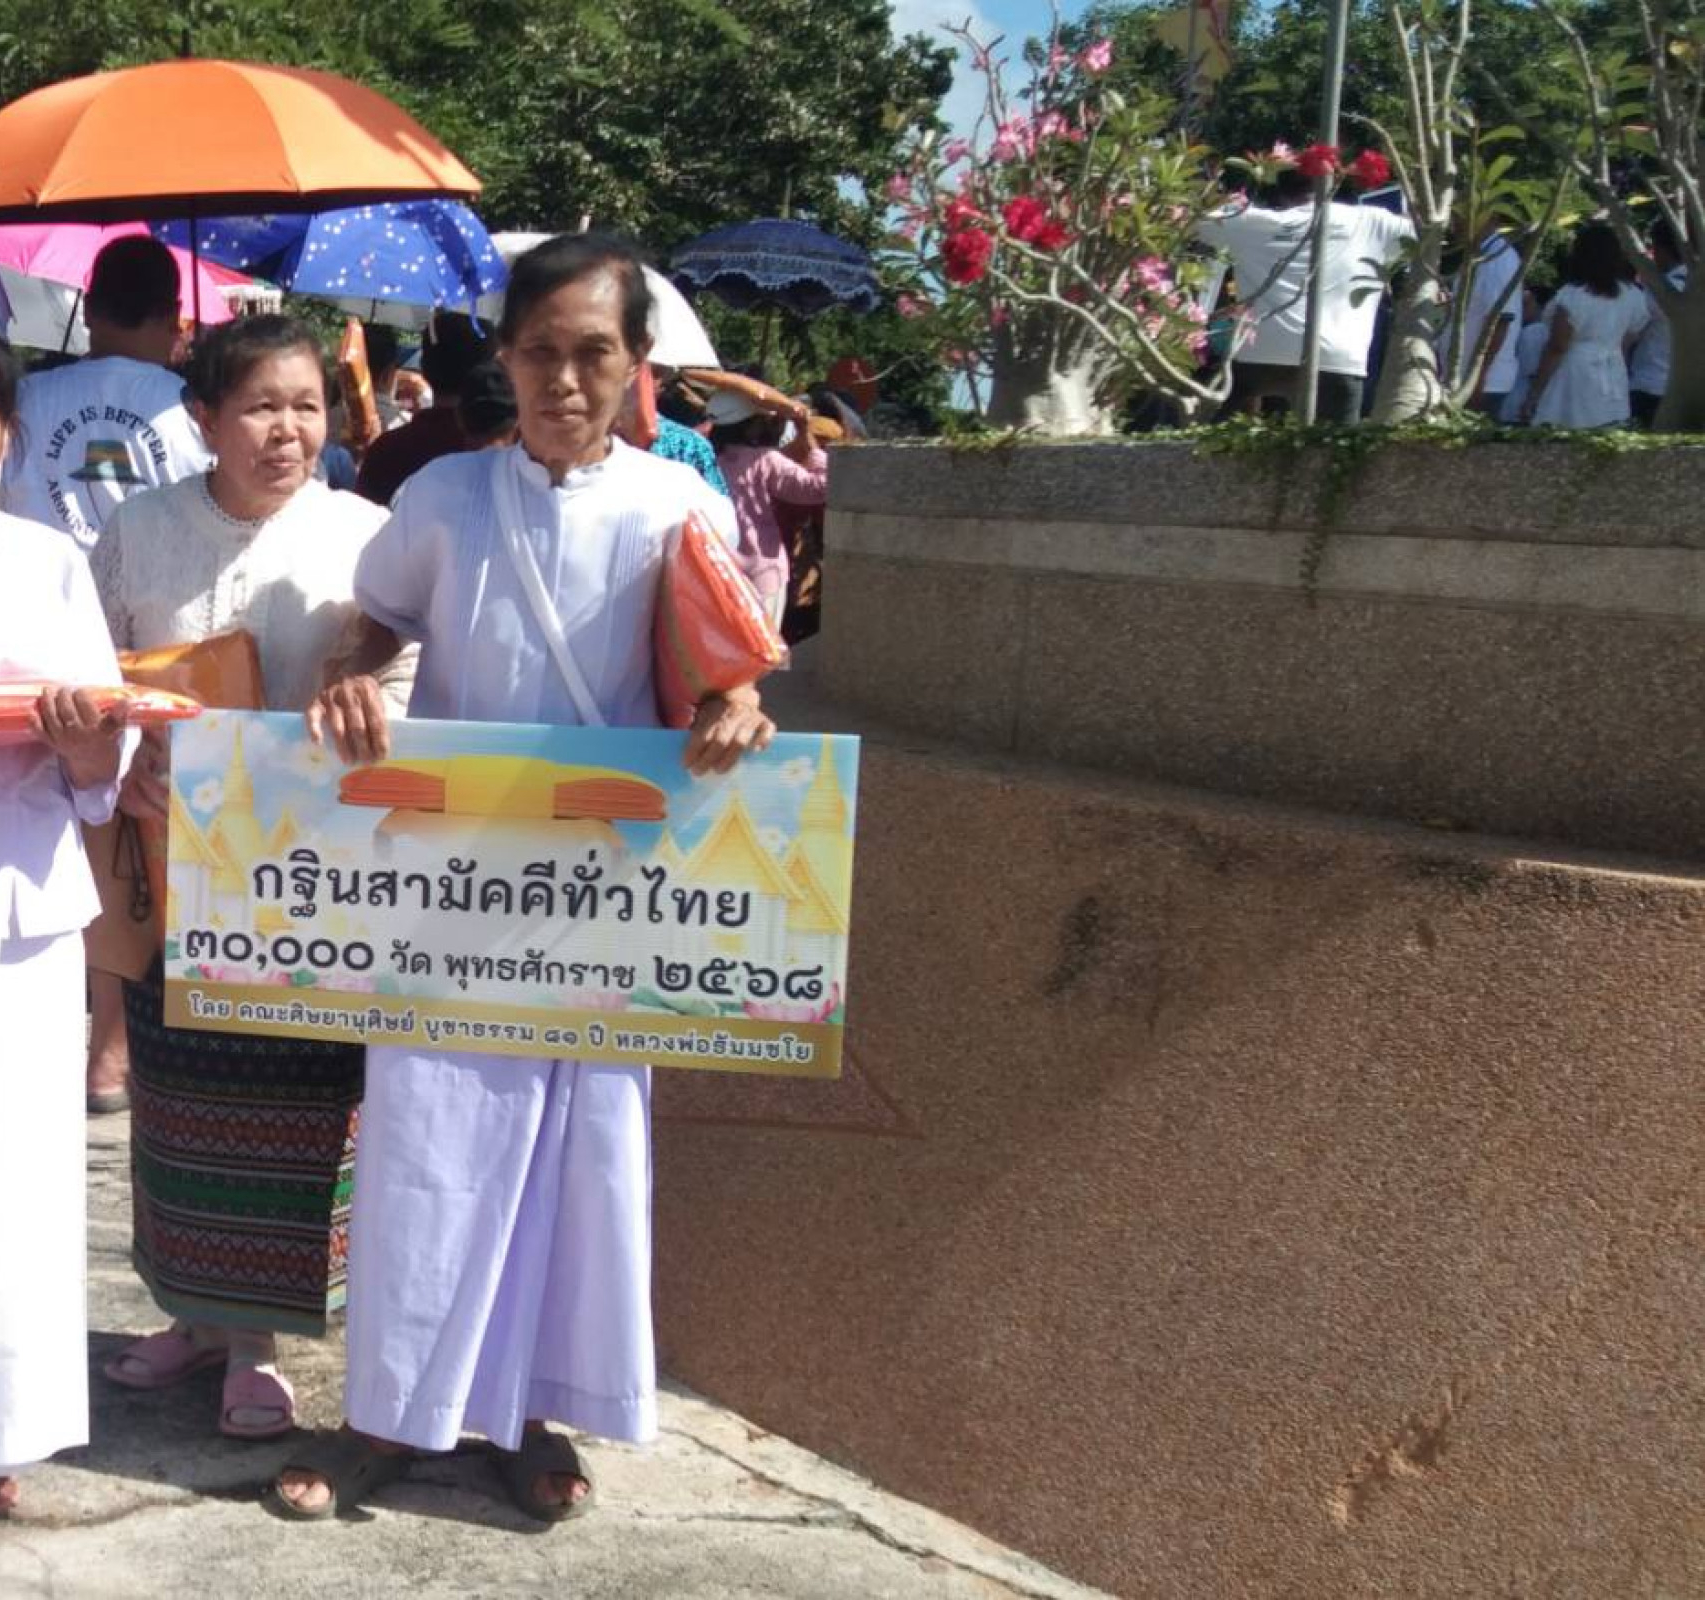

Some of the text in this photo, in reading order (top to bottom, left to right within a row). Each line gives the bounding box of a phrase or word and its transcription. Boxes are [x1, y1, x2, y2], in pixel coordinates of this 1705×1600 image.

[45, 405, 167, 465] LIFE IS BETTER
[253, 848, 751, 928] กฐินสามัคคีทั่วไทย
[186, 929, 824, 1000] ๓๐,๐๐๐ วัด พุทธศักราช ๒๕๖๘
[189, 992, 231, 1018] โดย
[238, 1001, 415, 1037] คณะศิษยานุศิษย์
[424, 1016, 535, 1042] บูชาธรรม
[544, 1029, 579, 1047] ๘๑
[588, 1024, 606, 1047] ปี
